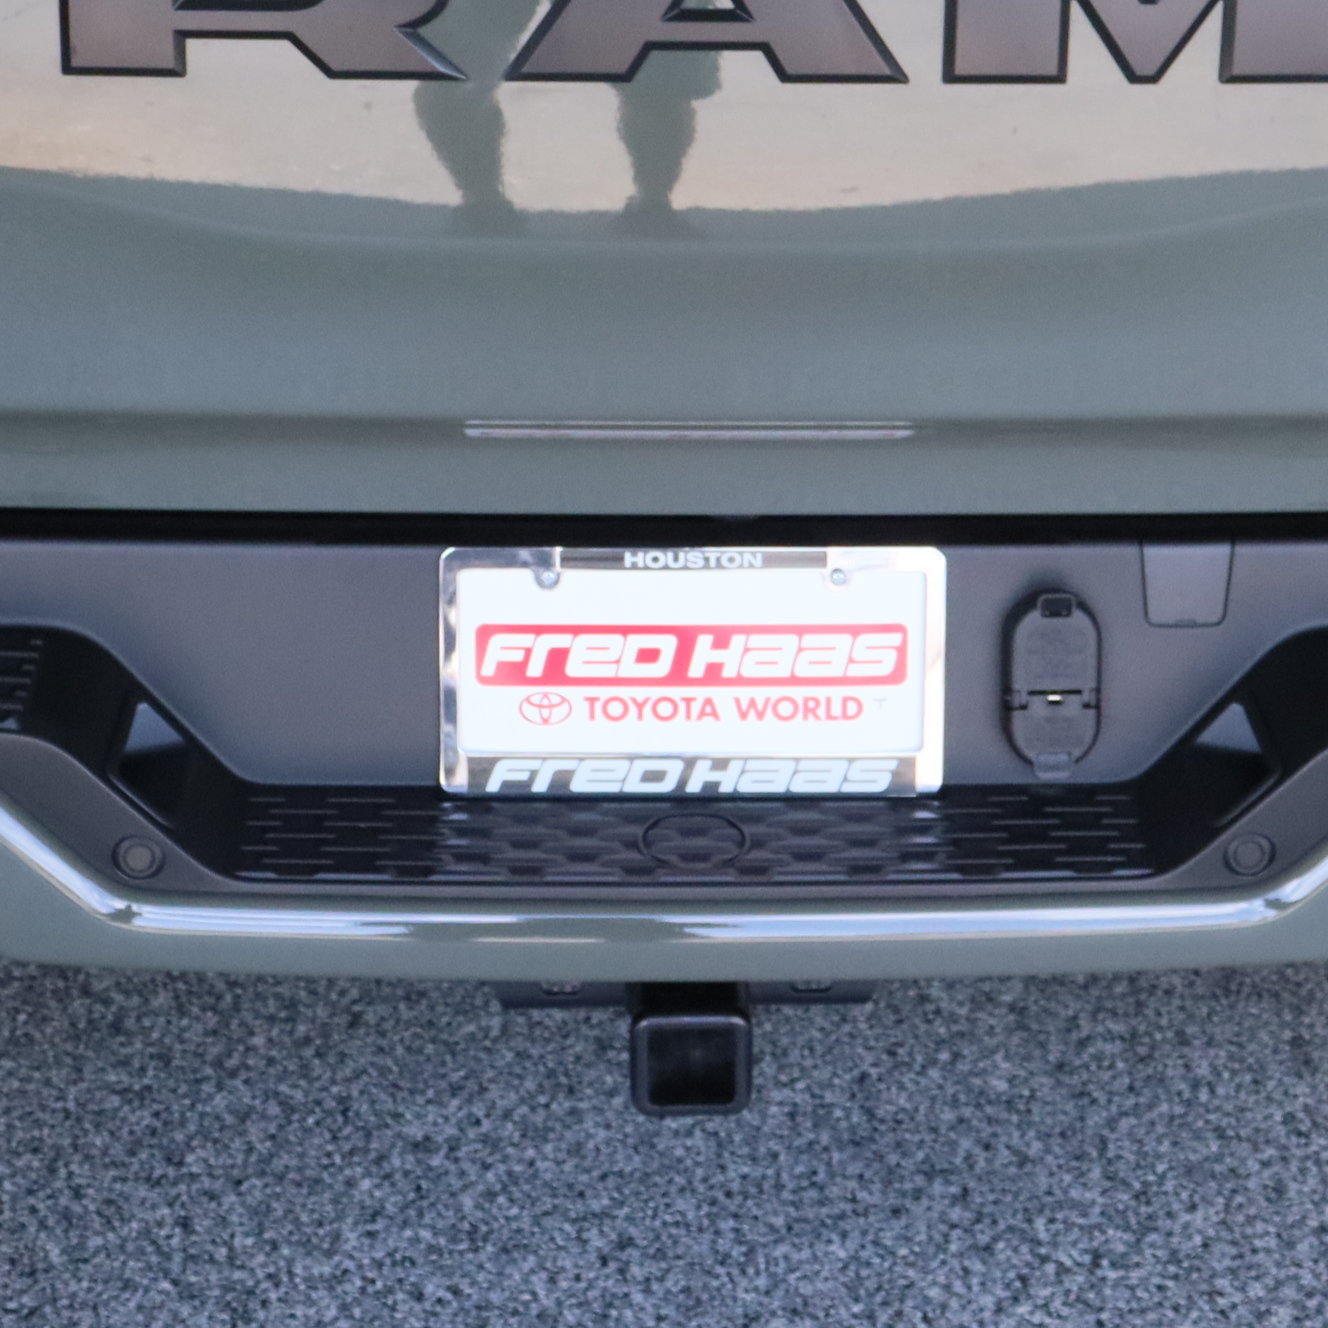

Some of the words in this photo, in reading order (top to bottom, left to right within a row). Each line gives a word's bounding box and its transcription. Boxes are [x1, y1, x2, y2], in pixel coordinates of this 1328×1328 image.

[624, 551, 763, 569] HOUSTON
[584, 696, 720, 722] TOYOTA
[734, 696, 863, 722] WORLD
